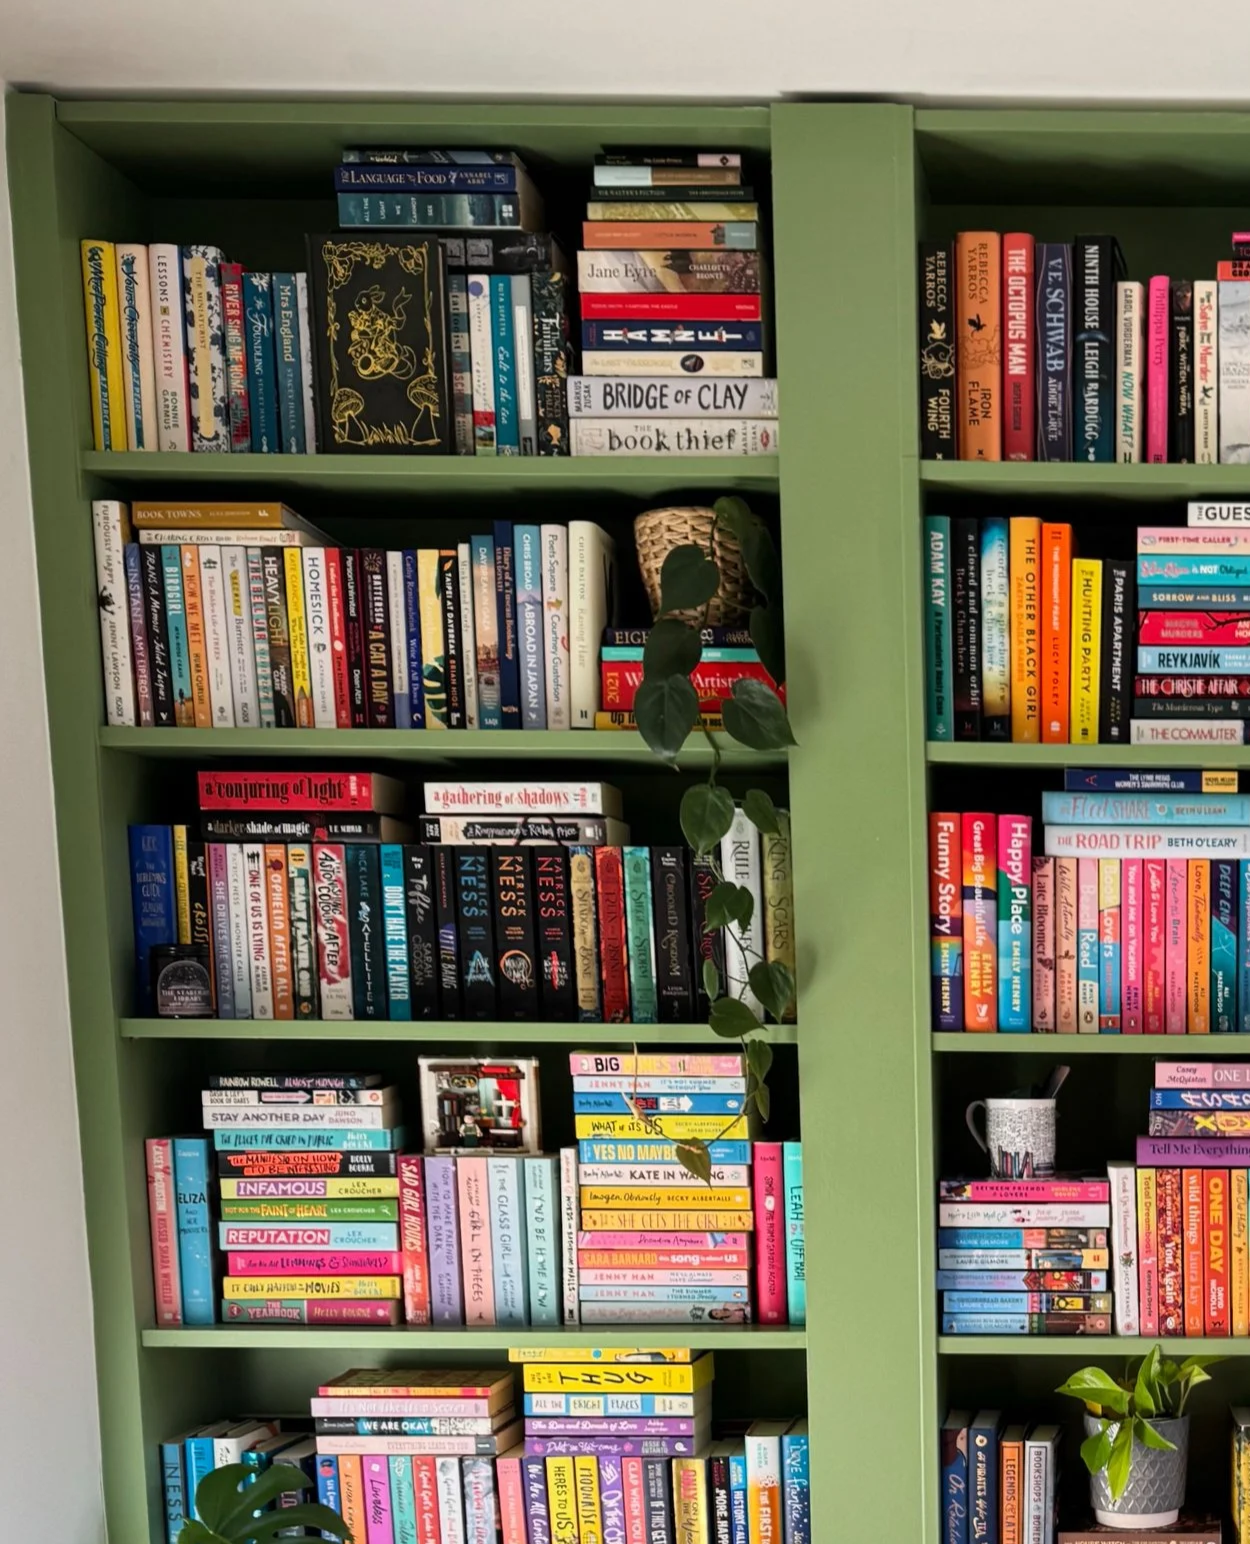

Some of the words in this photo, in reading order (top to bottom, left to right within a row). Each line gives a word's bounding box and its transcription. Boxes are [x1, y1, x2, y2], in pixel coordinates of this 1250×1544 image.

[587, 264, 620, 278] Jane
[625, 265, 656, 281] Eyre
[968, 247, 977, 299] YARROS
[979, 242, 988, 304] REBECCA
[1008, 249, 1026, 274] THE
[157, 255, 168, 306] LESSONS
[925, 256, 935, 307] YARROS
[937, 252, 946, 312] REBECCA
[1008, 279, 1026, 344] OCTOPUS
[160, 319, 173, 378] CHEMISTRY
[1008, 345, 1026, 375] MAN
[602, 383, 668, 411] BRIDGE
[698, 382, 748, 409] CLAY
[939, 389, 951, 438] FOURTH
[968, 381, 979, 426] FLAME
[982, 387, 992, 419] IRON
[928, 397, 938, 431] WING
[608, 429, 670, 451] book
[676, 428, 736, 449] thief
[930, 532, 944, 573] ADAM
[1025, 538, 1035, 564] THE
[308, 557, 324, 635] HOMESICK
[932, 580, 945, 607] KAY
[1025, 572, 1036, 619] OTHER
[1081, 577, 1092, 642] HUNTING
[525, 602, 536, 651] ABROAD
[527, 653, 536, 668] IN
[1026, 629, 1036, 680] BLACK
[1081, 648, 1092, 692] PARTY
[1158, 651, 1220, 669] REYKJAVÍK
[528, 671, 538, 708] JAPAN
[1026, 687, 1036, 721] GIRL
[1150, 729, 1170, 740] THE
[1170, 728, 1236, 740] COMMUTER
[217, 779, 289, 802] conjuring
[307, 778, 343, 801] light
[938, 821, 954, 878] Funny
[1007, 822, 1027, 884] Happy
[1058, 836, 1072, 846] THE
[1076, 834, 1118, 847] ROAD
[1168, 838, 1193, 847] BETH
[1196, 838, 1237, 848] O'LEARY
[935, 884, 955, 934] Story
[1011, 888, 1027, 934] Place
[1012, 941, 1021, 972] EMILY
[594, 1057, 620, 1072] BIG
[1215, 1070, 1240, 1082] ONE
[212, 1113, 238, 1122] STAY
[242, 1113, 299, 1122] ANOTHER
[303, 1113, 325, 1122] DAY
[1151, 1143, 1170, 1155] Tell
[1173, 1143, 1191, 1155] Me
[238, 1182, 325, 1194] INFAMOUS
[1209, 1177, 1223, 1224] ONE
[228, 1231, 329, 1243] REPUTATION
[1209, 1231, 1222, 1272] DAY
[381, 1422, 398, 1430] ARE
[401, 1422, 428, 1431] OKAY
